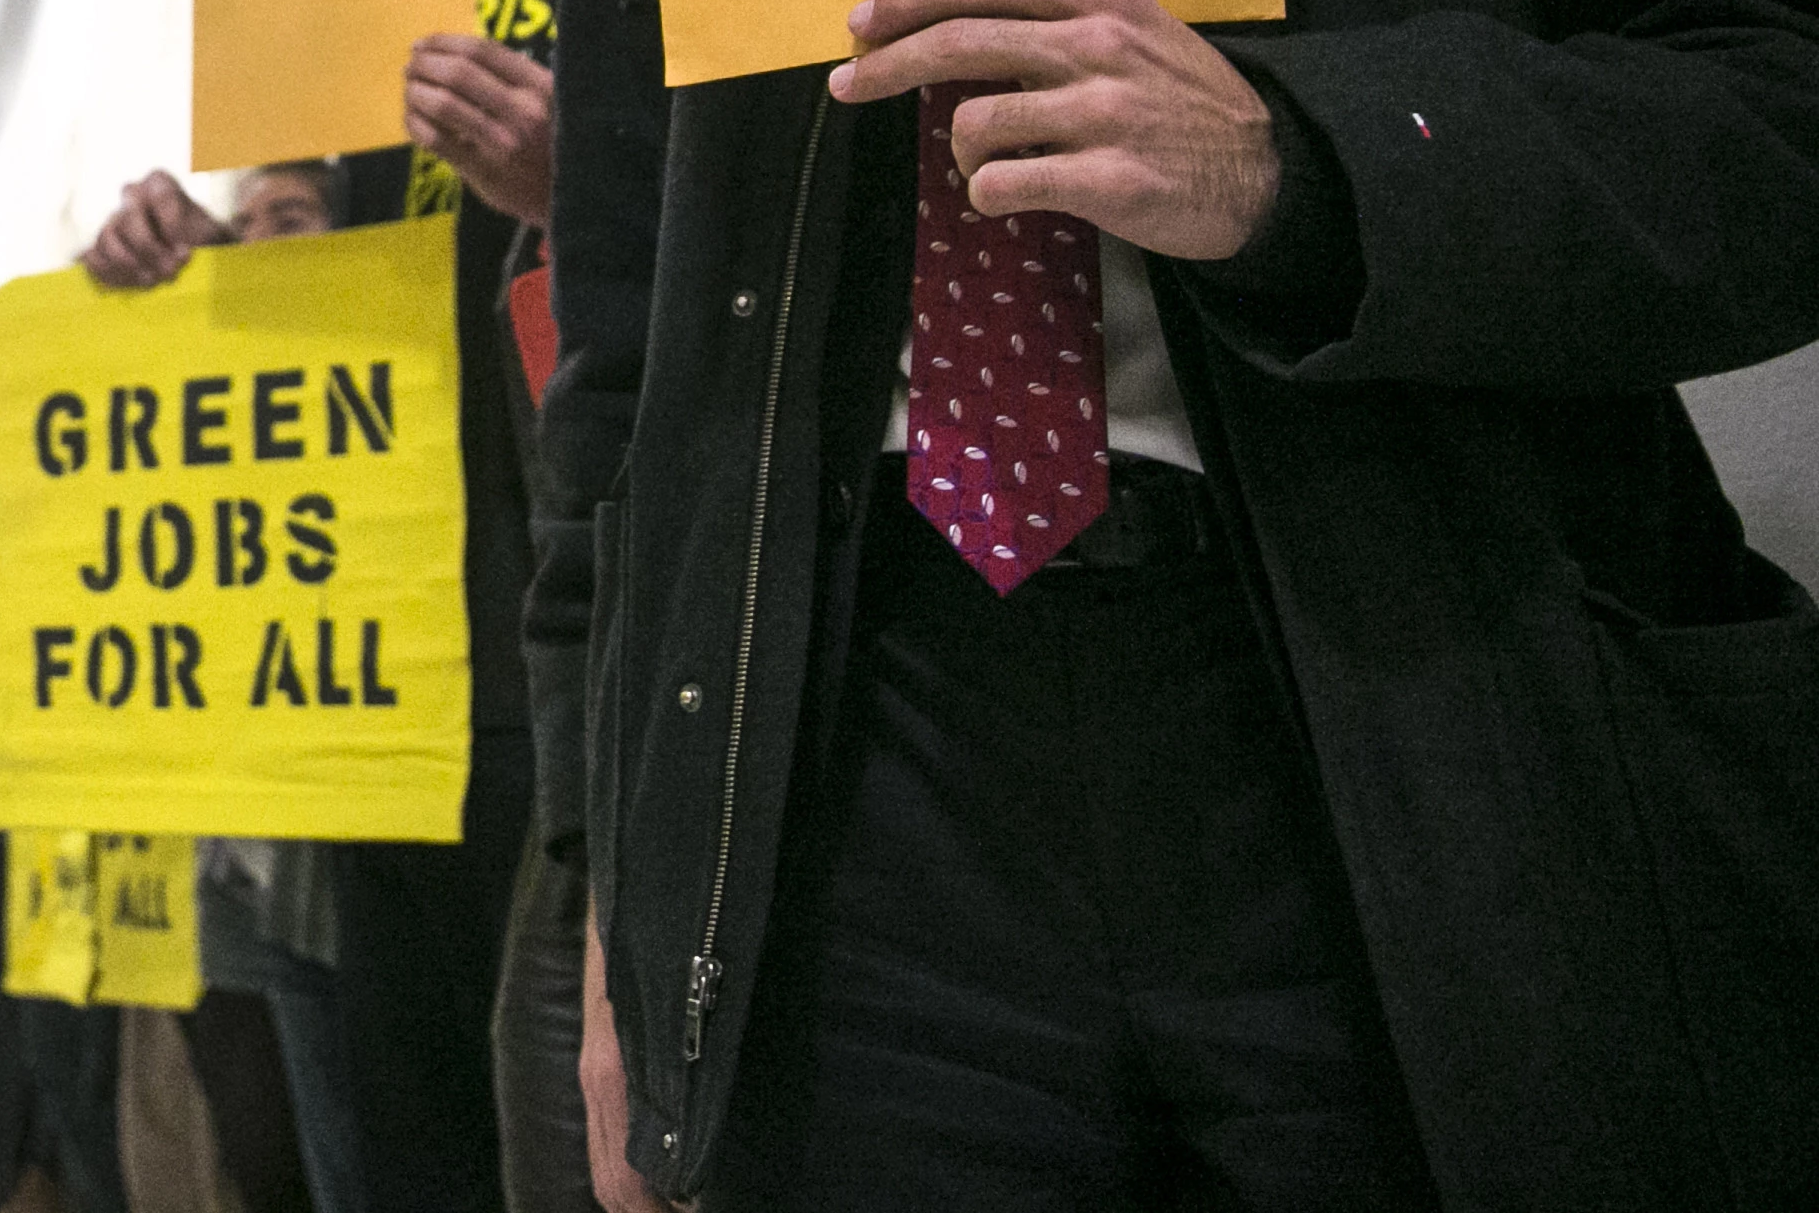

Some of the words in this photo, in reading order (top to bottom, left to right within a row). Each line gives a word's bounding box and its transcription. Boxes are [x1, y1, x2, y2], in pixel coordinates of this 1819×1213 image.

[34, 360, 397, 478] GREEN
[79, 492, 340, 593] JOBS
[34, 625, 206, 710] FOR
[250, 618, 399, 709] ALL
[111, 874, 172, 931] ALL
